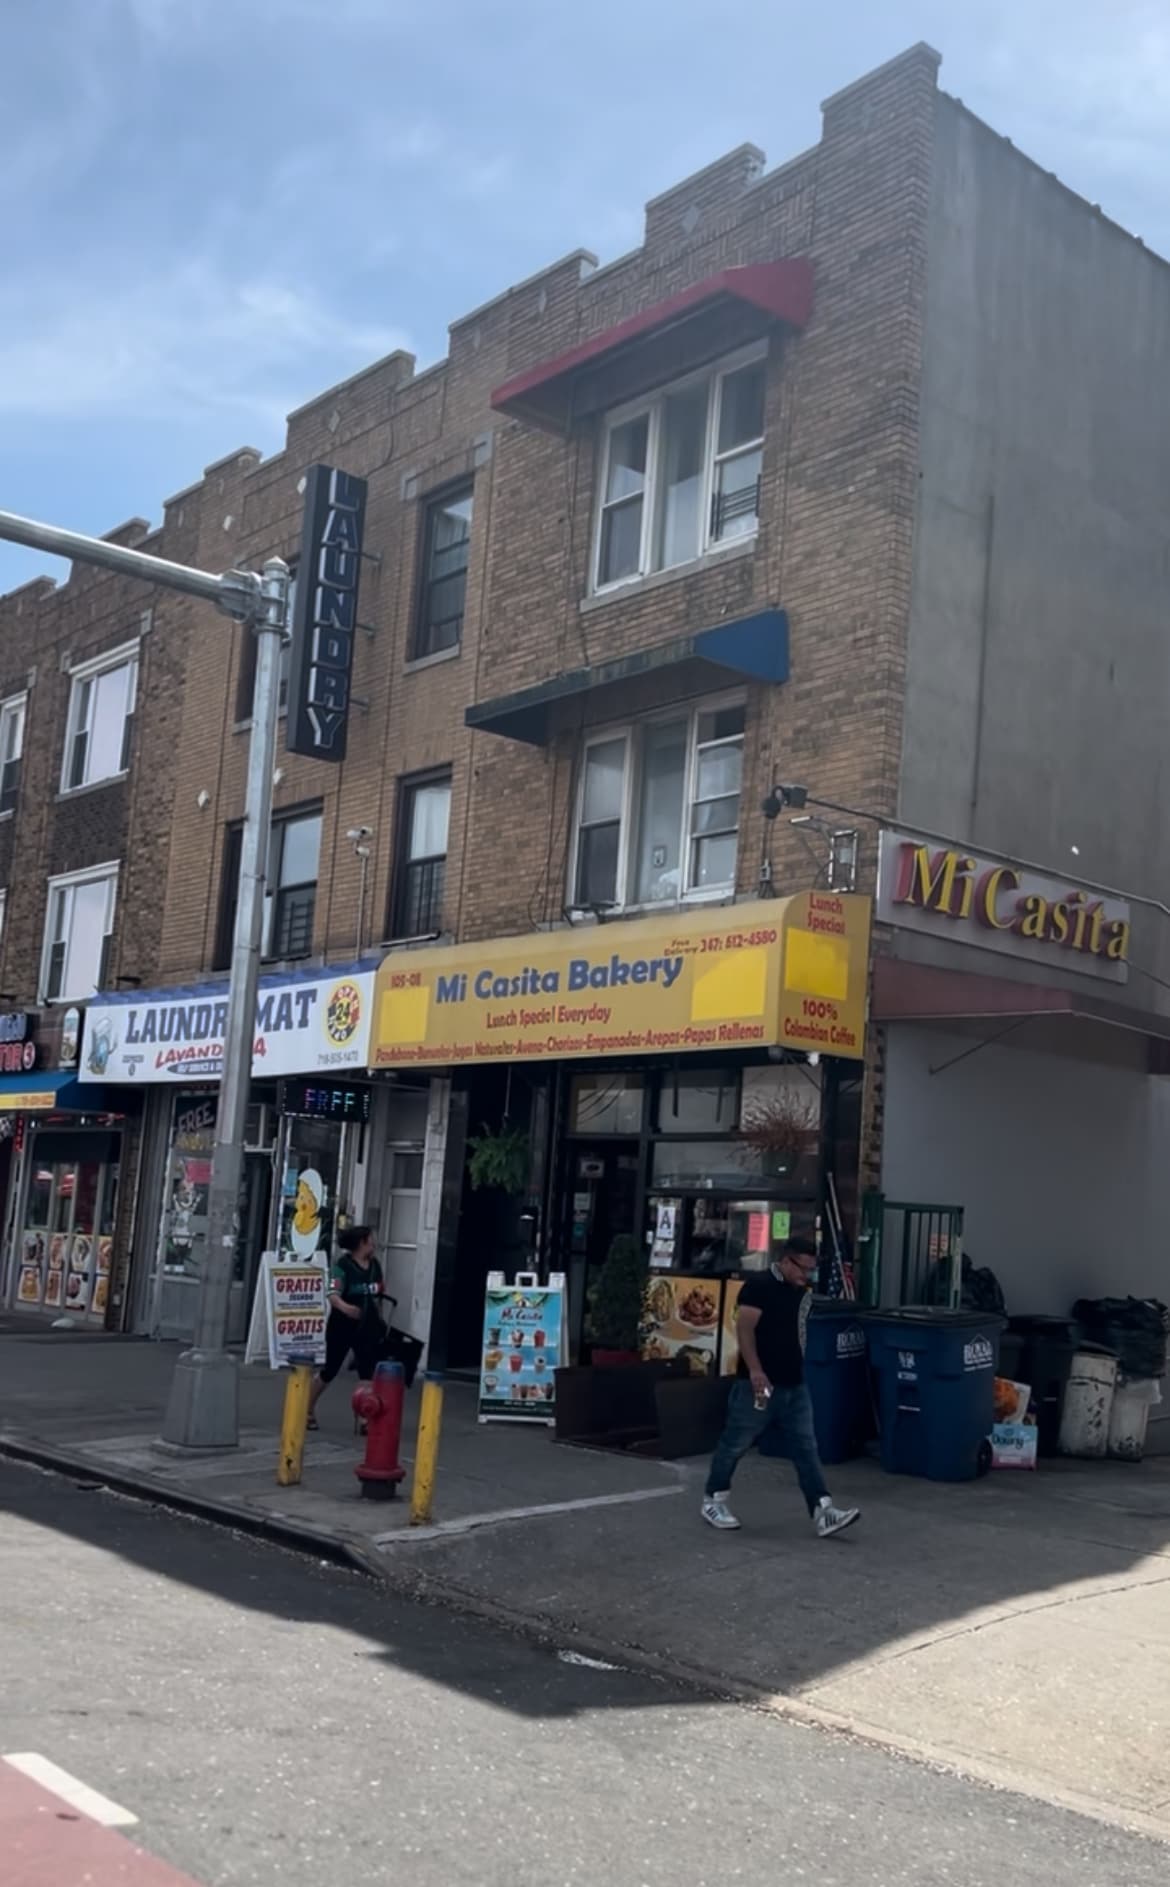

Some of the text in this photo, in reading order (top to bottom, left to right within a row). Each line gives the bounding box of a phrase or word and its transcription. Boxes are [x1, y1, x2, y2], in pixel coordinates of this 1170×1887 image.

[307, 468, 360, 749] LAUNDRY
[809, 892, 842, 914] Lunch
[892, 841, 1130, 962] Mi Casita
[807, 911, 845, 935] Special
[435, 954, 684, 1003] Mi Casita Bakery
[125, 988, 318, 1045] LAUNDRMAT
[486, 1002, 612, 1029] Lunch Special Everyday
[803, 1000, 838, 1021] 100%
[718, 1023, 765, 1043] Rellenas
[784, 1017, 855, 1046] Colombian Coffee
[660, 1210, 671, 1230] A
[276, 1277, 323, 1294] GRATIS
[277, 1319, 325, 1336] GRATIS
